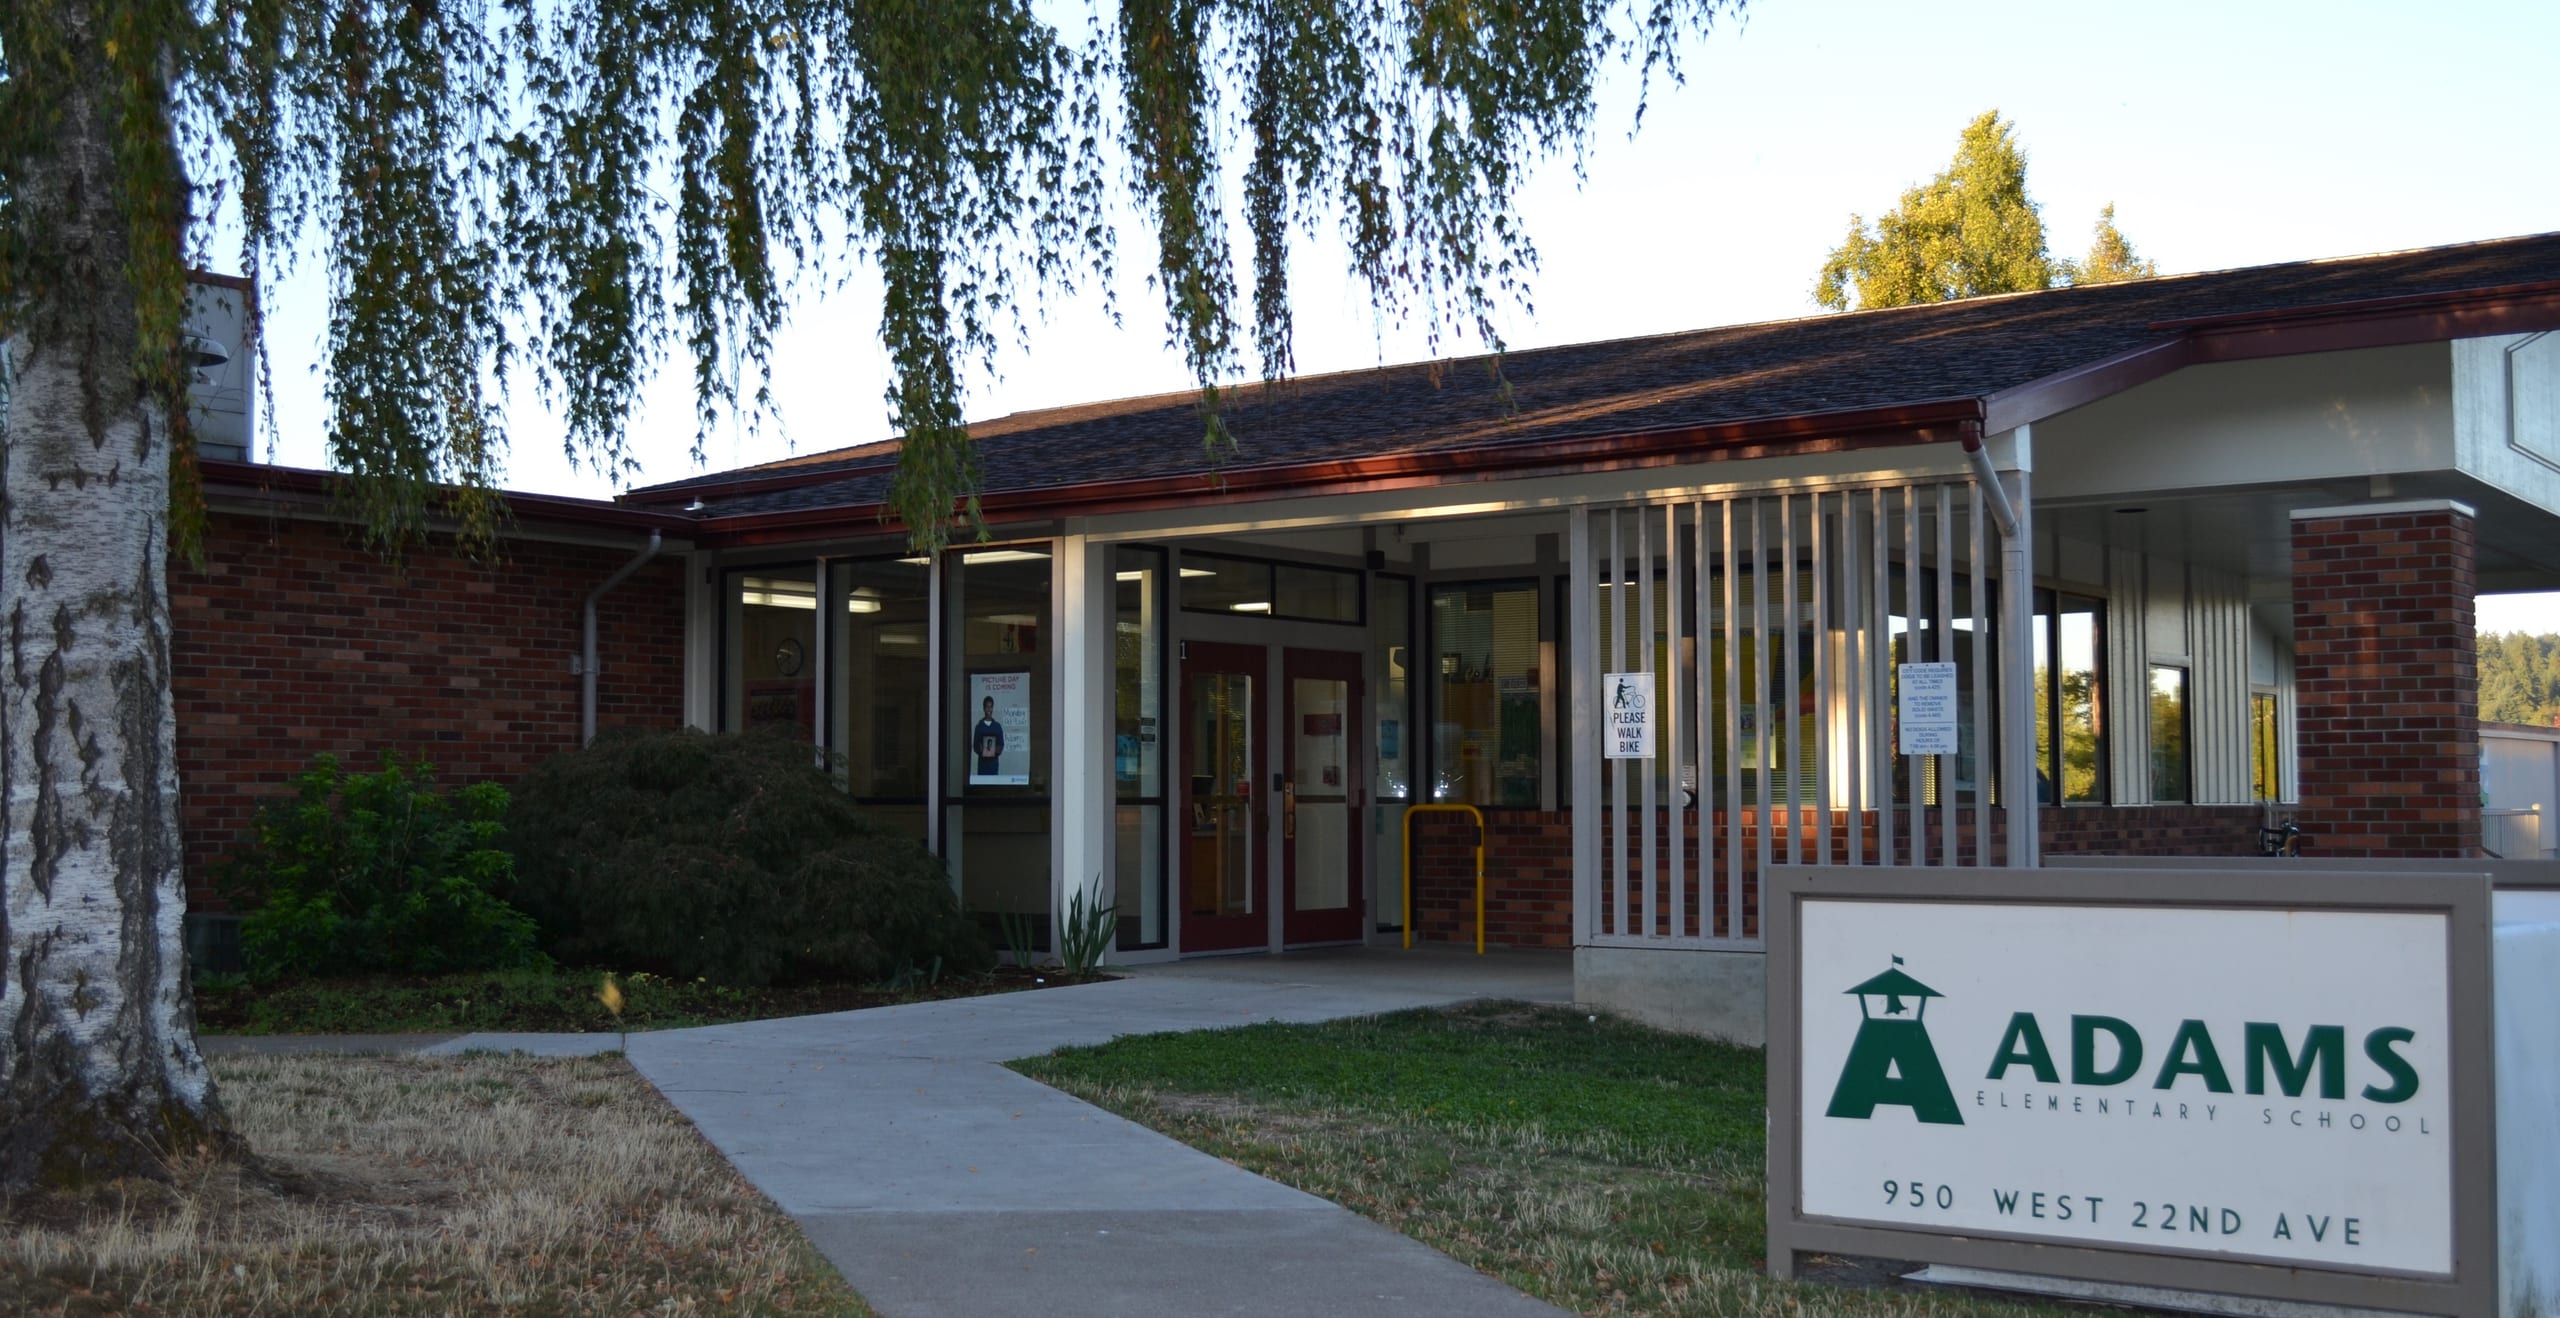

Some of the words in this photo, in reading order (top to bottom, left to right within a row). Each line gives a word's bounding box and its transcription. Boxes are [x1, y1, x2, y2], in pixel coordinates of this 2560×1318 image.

[1613, 712, 1645, 724] PLEASE
[1617, 727, 1642, 739] WALK
[1619, 741, 1640, 753] BIKE
[1985, 1011, 2420, 1104] ADAMS
[1975, 1090, 2219, 1121] ELEMENTARY
[2263, 1108, 2430, 1135] SCHOOL
[1882, 1180, 1954, 1210] 950
[1993, 1188, 2104, 1222] WEST
[2131, 1201, 2242, 1236] 22ND
[2273, 1213, 2360, 1246] AVE
